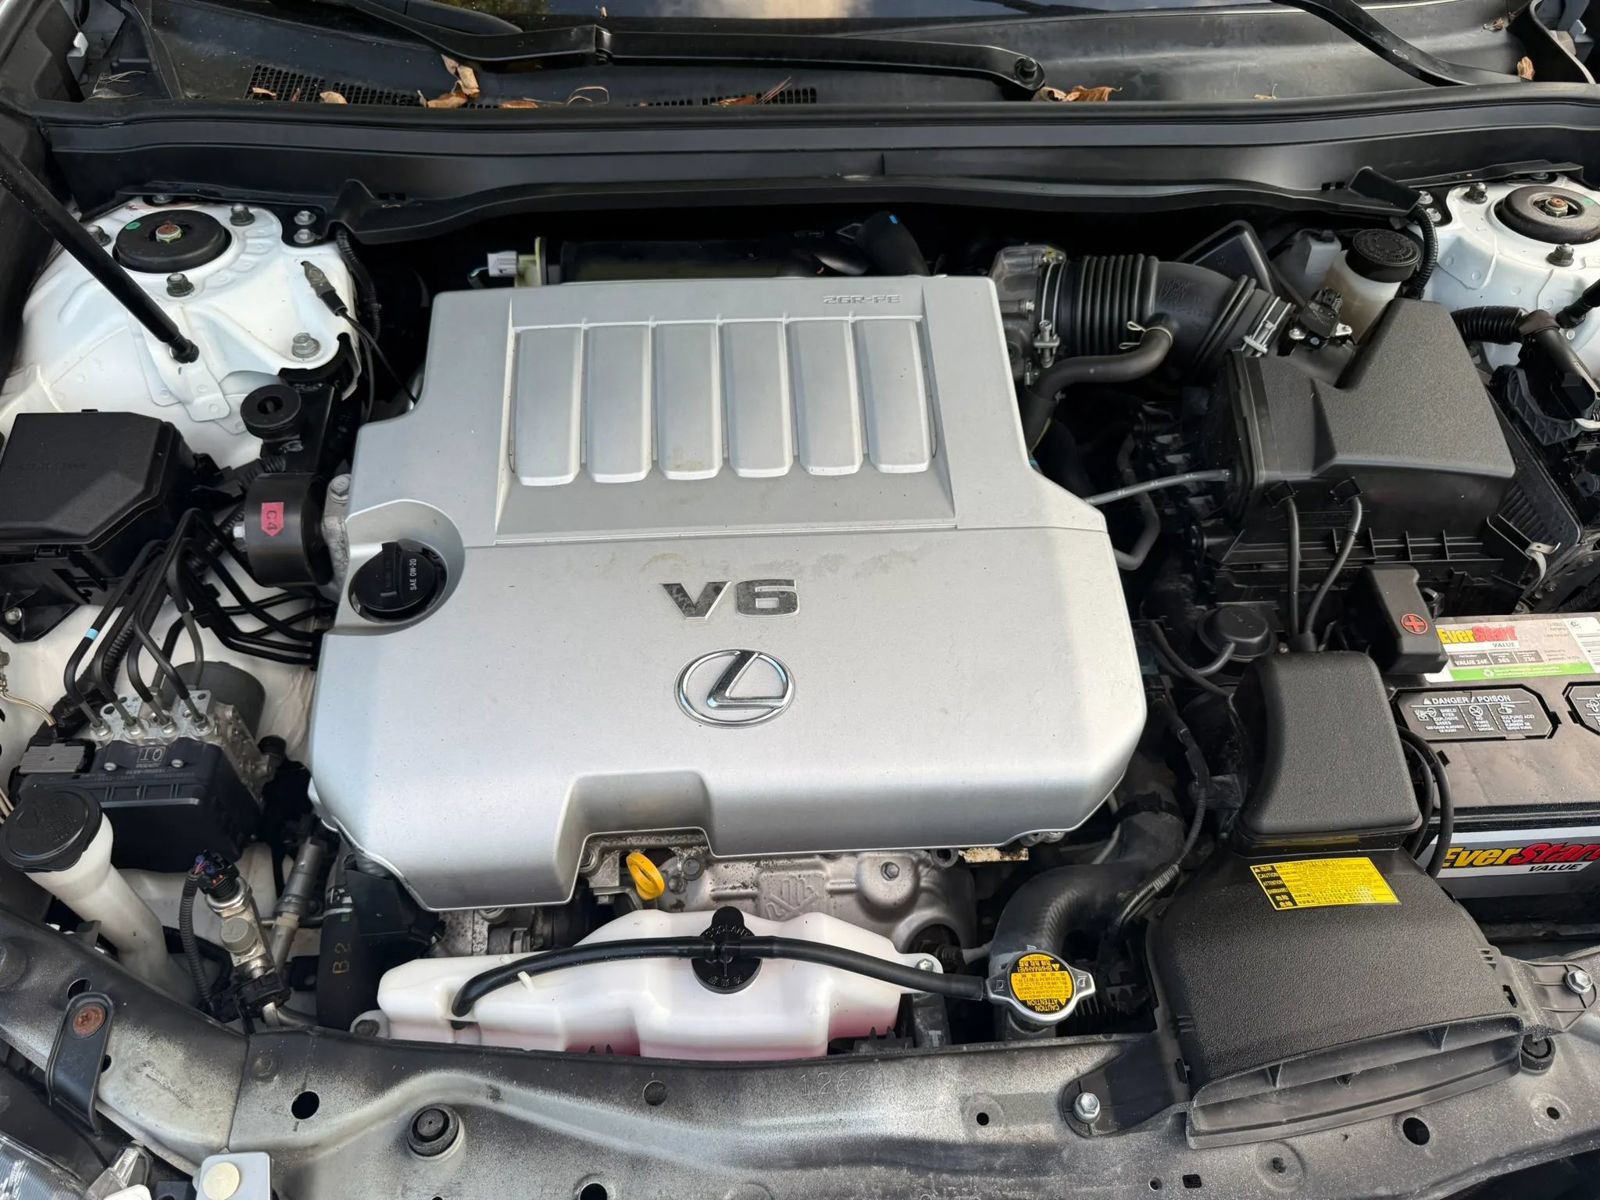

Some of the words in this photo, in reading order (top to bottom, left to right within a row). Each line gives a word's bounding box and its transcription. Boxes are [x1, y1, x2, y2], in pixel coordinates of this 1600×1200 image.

[409, 558, 417, 577] 0W-20
[409, 578, 417, 591] SAE
[660, 578, 800, 620] V6
[1431, 696, 1469, 705] DANGER
[1477, 694, 1511, 703] POISON
[1528, 863, 1582, 872] VALUE
[1026, 998, 1058, 1006] ATTENTION
[1035, 1004, 1060, 1012] CAUTION
